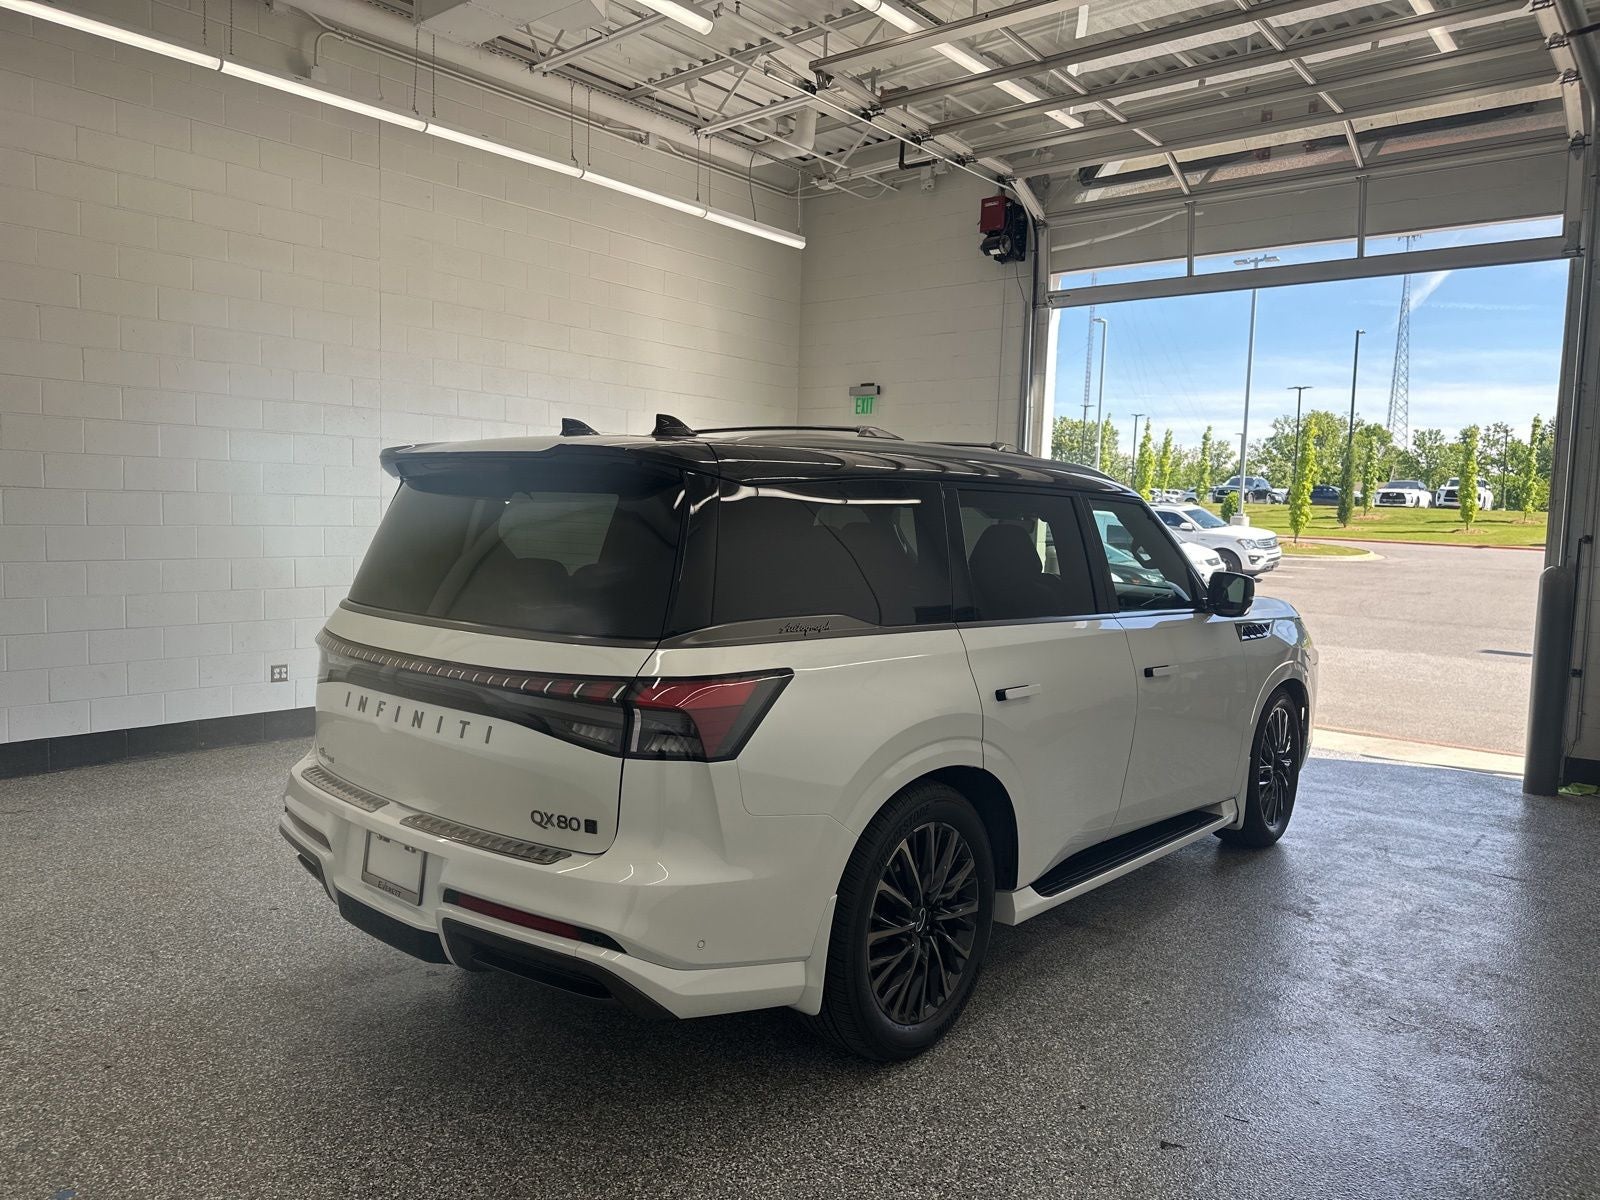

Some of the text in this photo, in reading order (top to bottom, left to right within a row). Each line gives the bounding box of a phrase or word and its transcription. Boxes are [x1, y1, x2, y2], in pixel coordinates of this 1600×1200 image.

[855, 397, 875, 415] EXIT
[345, 691, 493, 744] INFINITI
[530, 809, 581, 832] QX80
